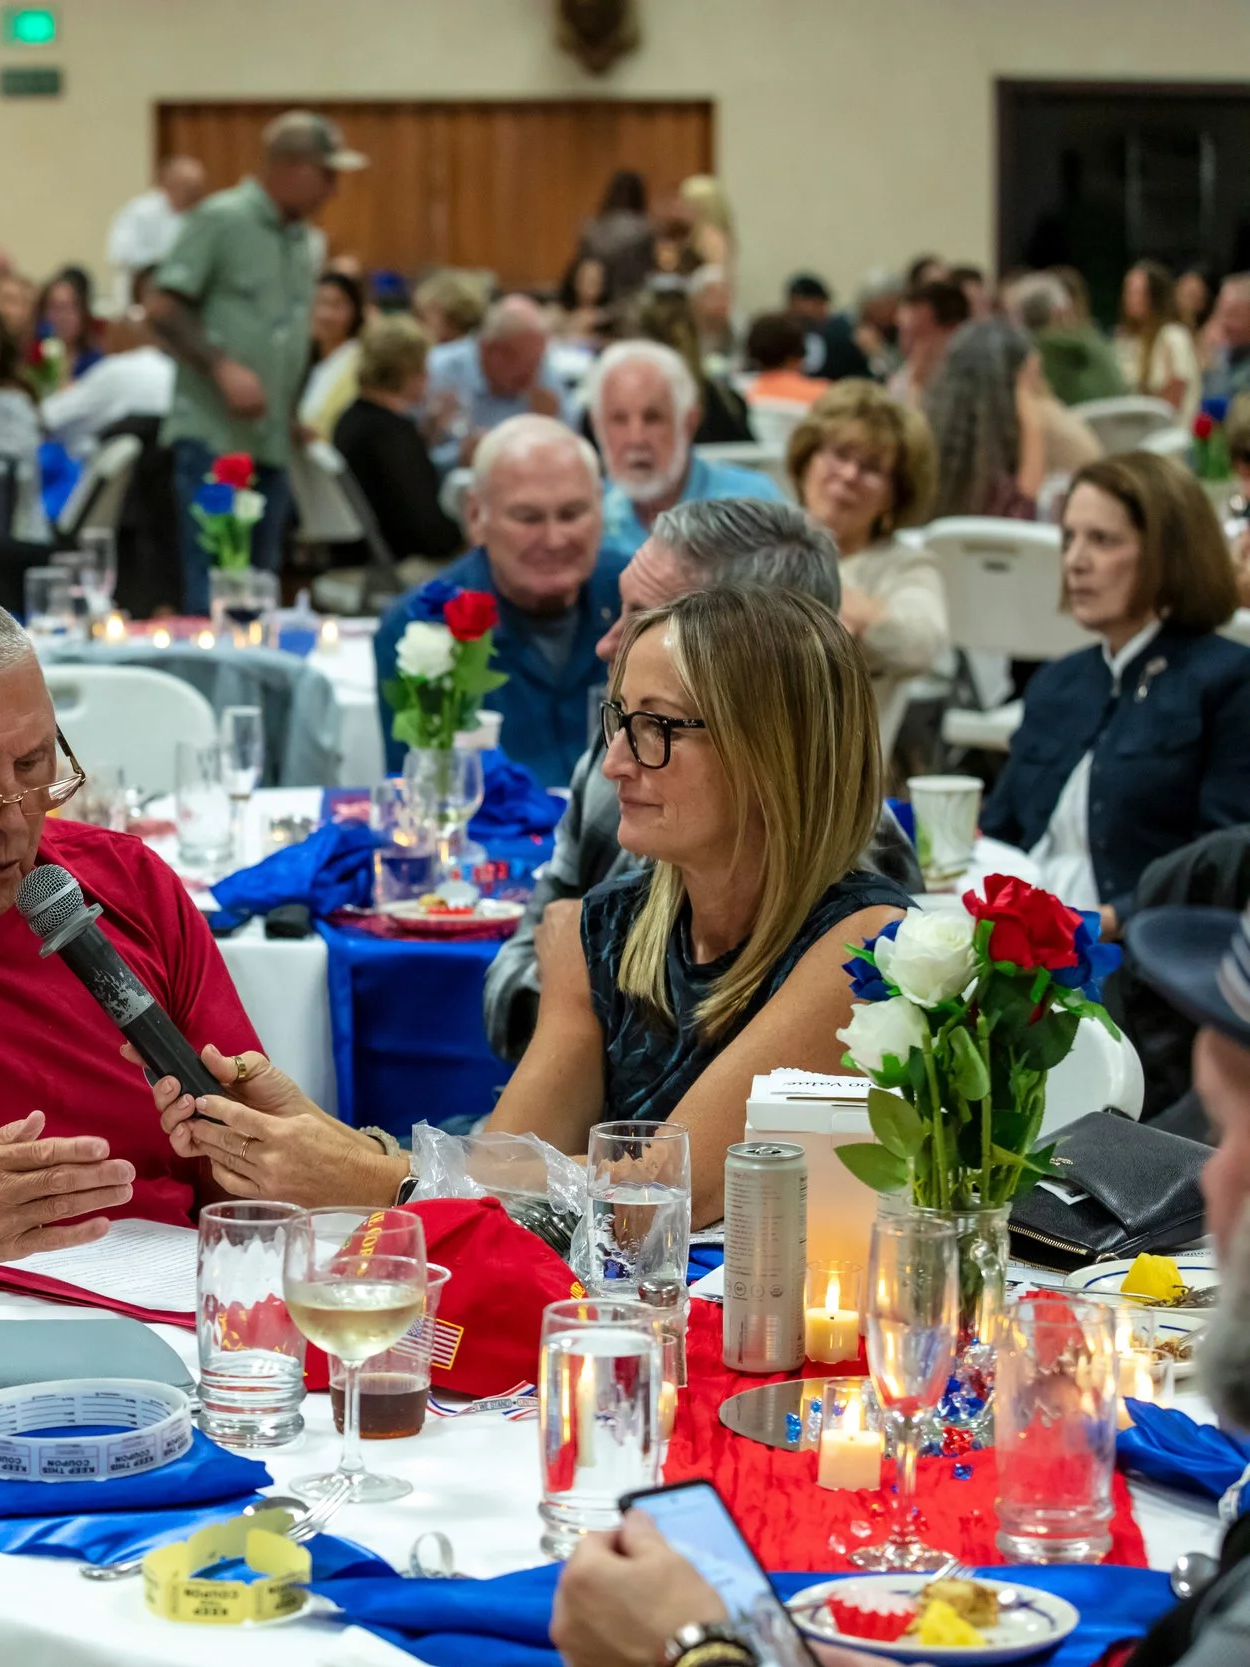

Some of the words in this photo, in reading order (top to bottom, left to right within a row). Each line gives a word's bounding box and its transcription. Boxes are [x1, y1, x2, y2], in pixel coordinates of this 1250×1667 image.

[115, 1449, 150, 1463] COUPON
[47, 1459, 90, 1467] COUPON
[133, 1456, 154, 1467] KEEP
[2, 1463, 27, 1473] KEEP
[42, 1466, 65, 1474] THIS
[68, 1466, 95, 1474] KEEP
[110, 1462, 130, 1471] THIS
